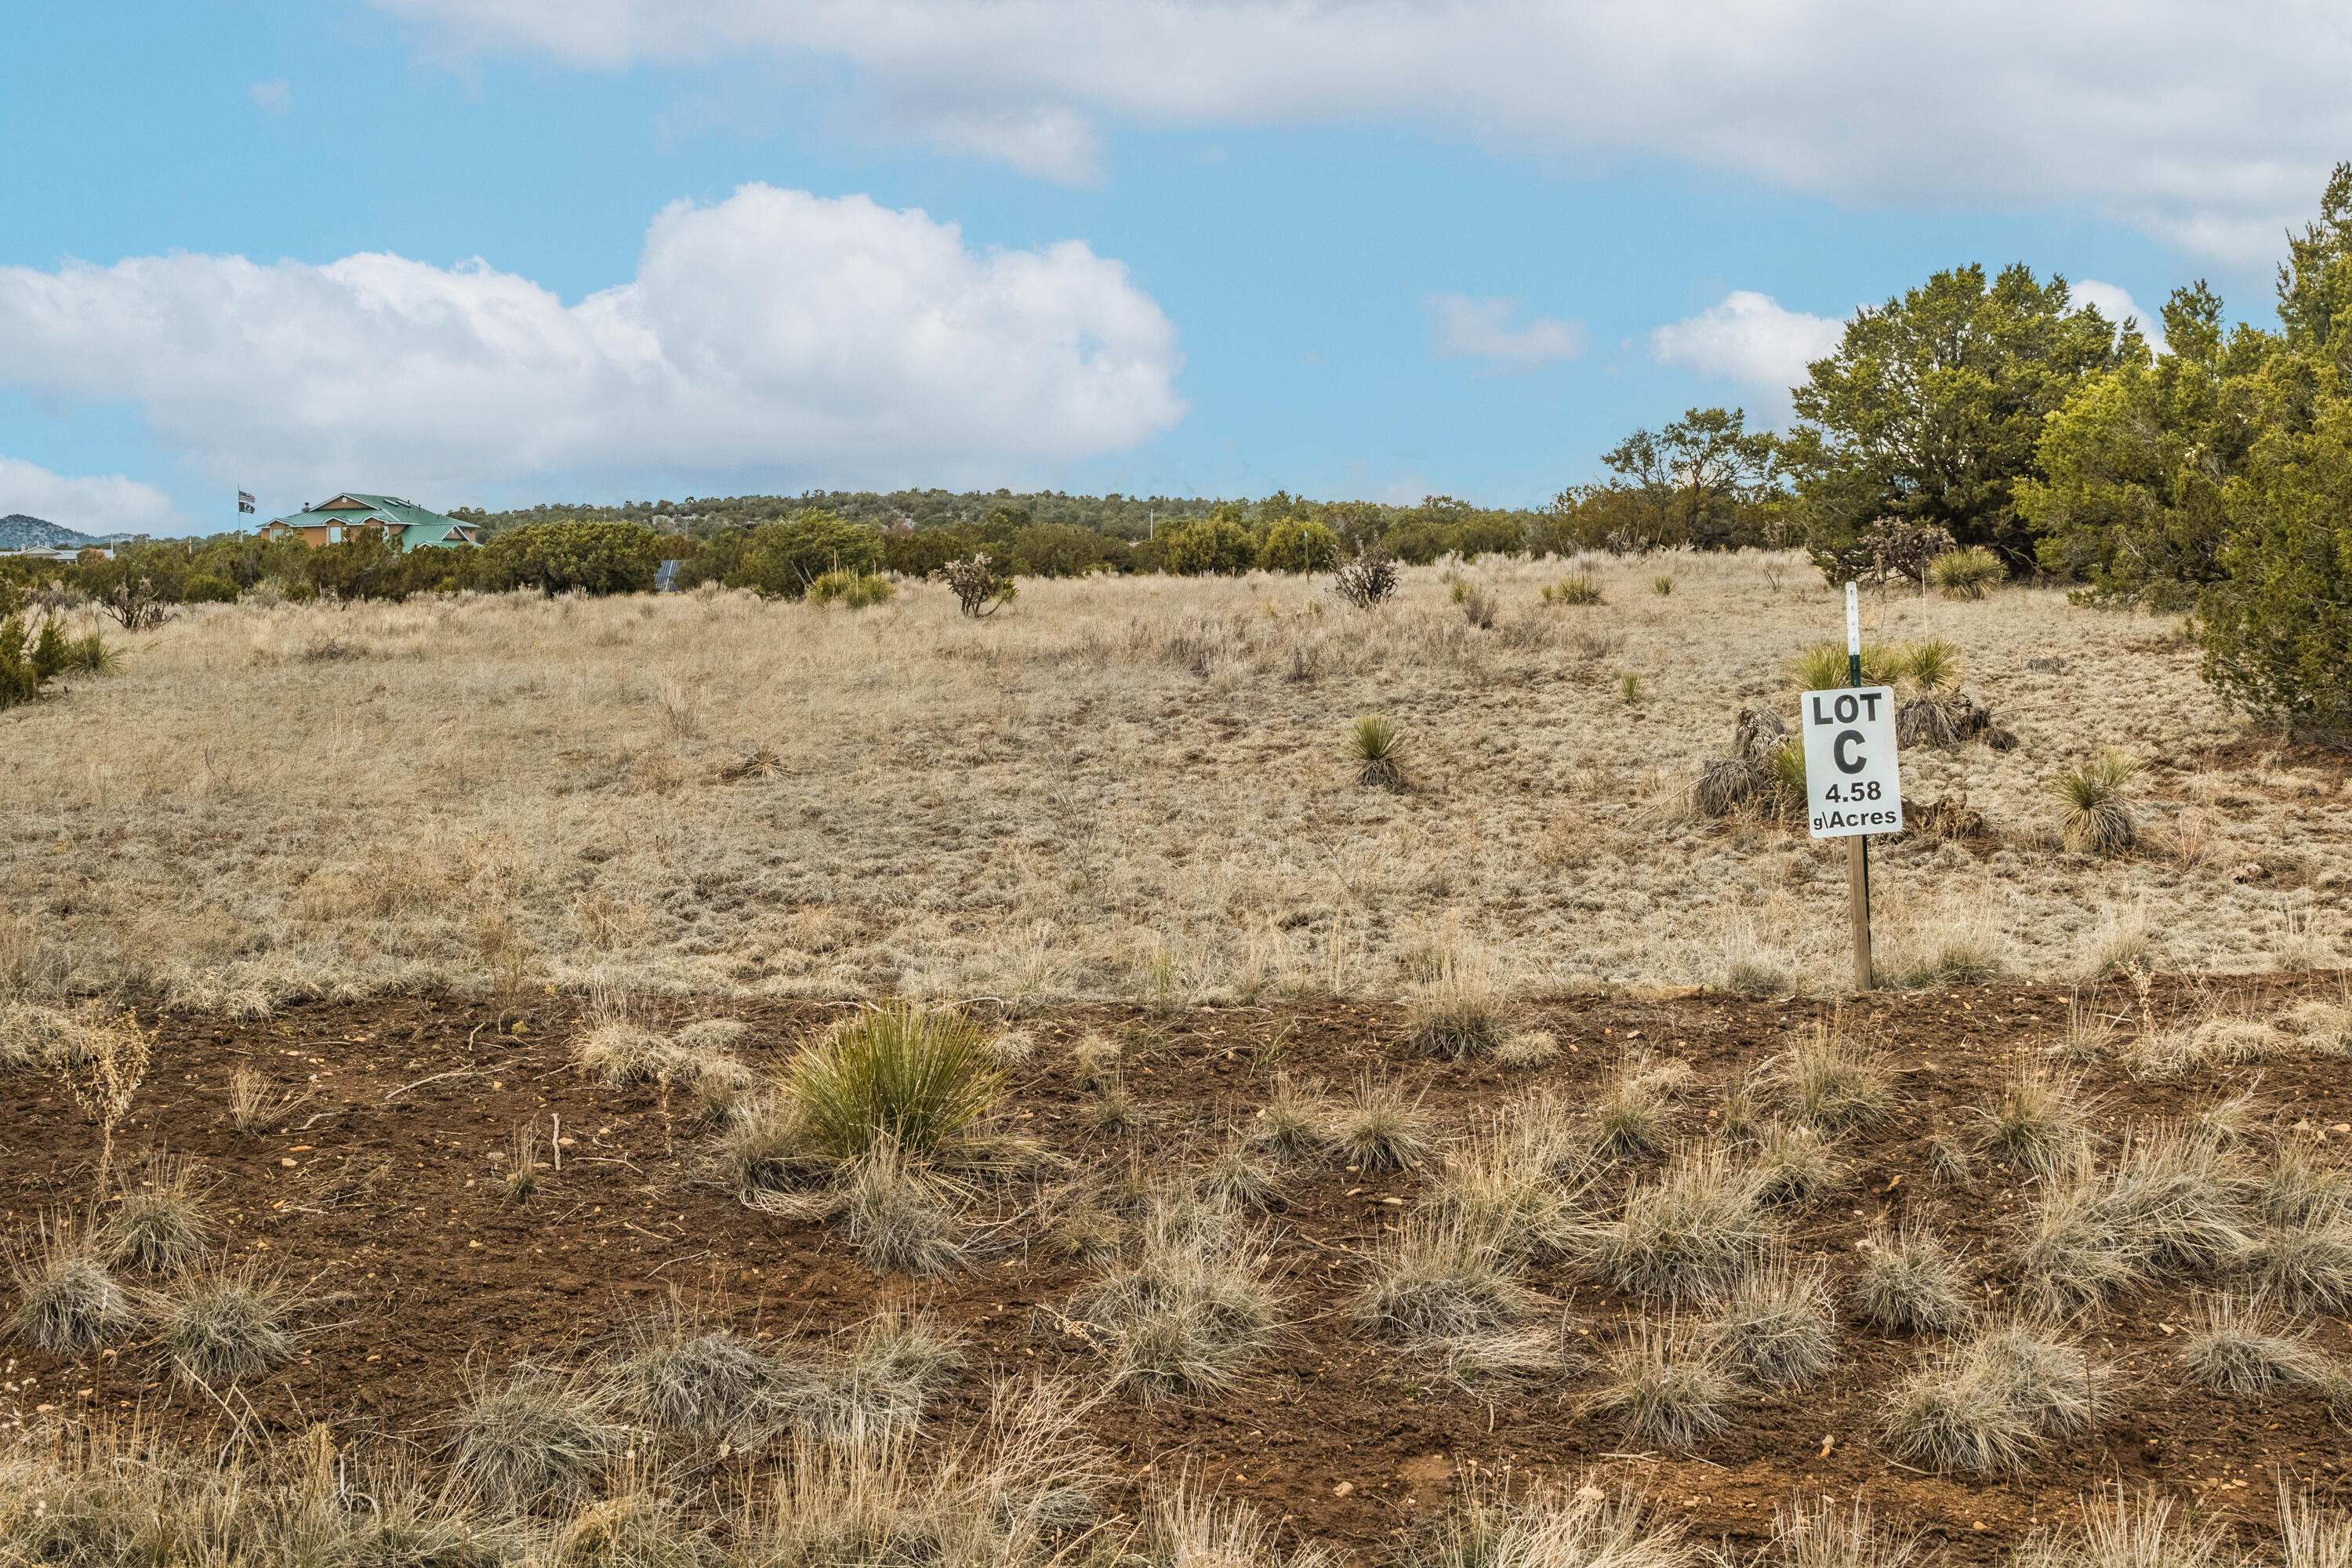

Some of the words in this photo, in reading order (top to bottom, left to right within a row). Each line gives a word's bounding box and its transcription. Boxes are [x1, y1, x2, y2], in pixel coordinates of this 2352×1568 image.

[1813, 692, 1882, 725] LOT
[1834, 729, 1867, 775] C
[1825, 781, 1882, 803] 4.58
